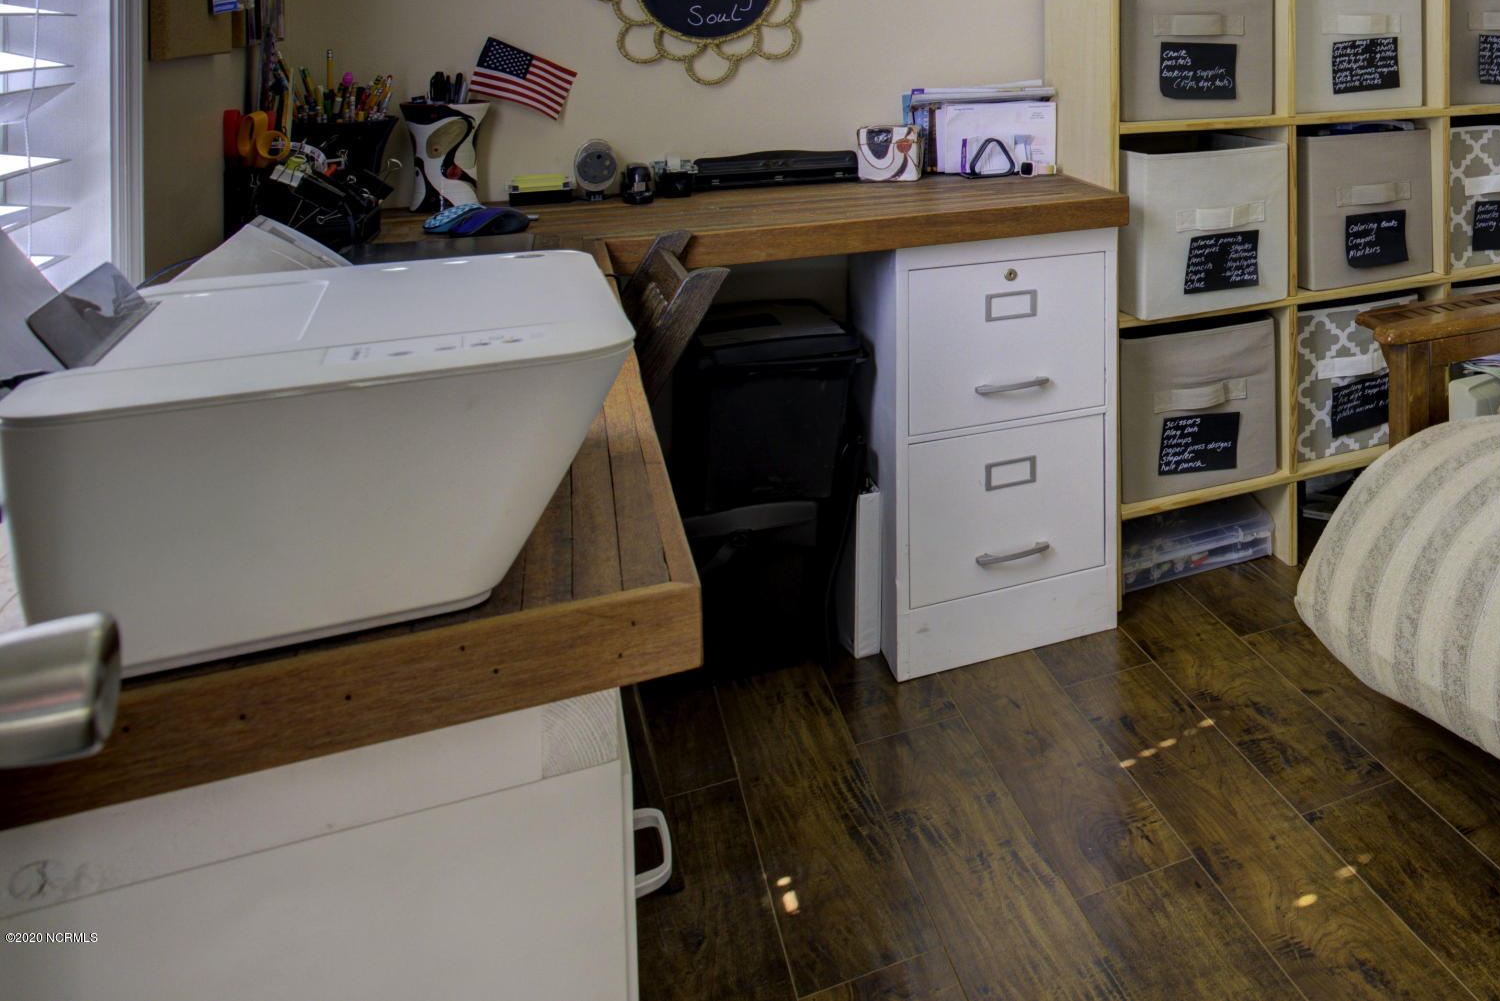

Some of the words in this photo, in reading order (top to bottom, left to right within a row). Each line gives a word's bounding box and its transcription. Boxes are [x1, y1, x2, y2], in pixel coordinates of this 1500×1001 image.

[687, 3, 742, 26] Soul
[1349, 222, 1378, 234] Coloring
[1165, 417, 1201, 429] Scissors
